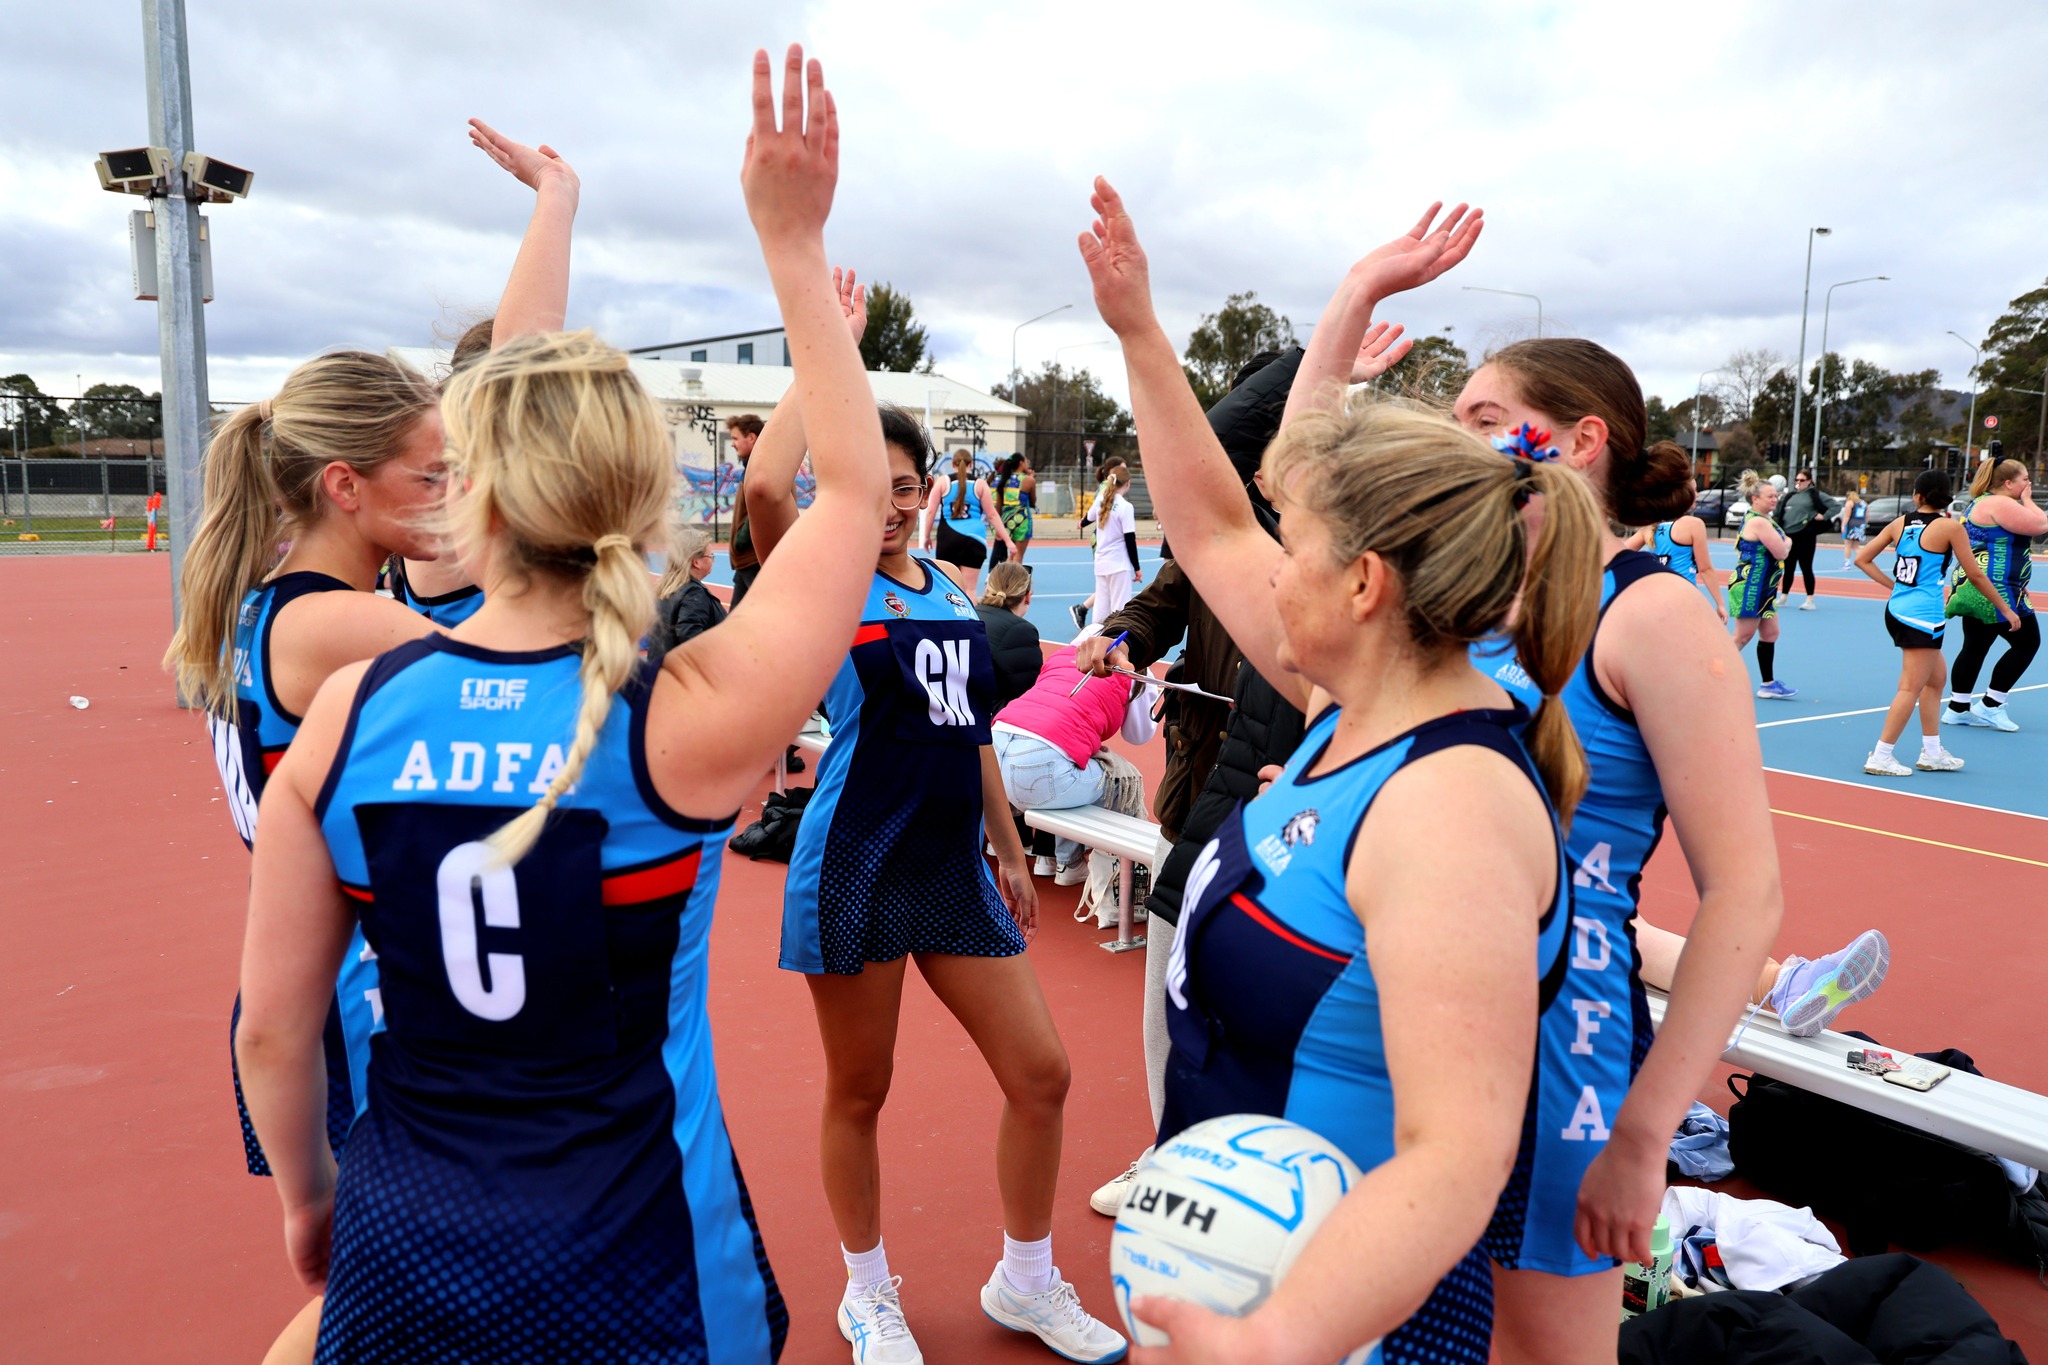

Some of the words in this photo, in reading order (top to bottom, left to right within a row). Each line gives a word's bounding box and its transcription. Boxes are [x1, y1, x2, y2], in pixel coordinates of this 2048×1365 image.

[1745, 585, 1758, 612] SOUTH
[459, 696, 526, 711] SPORT
[392, 739, 577, 796] ADFA
[436, 840, 527, 1022] C
[1561, 841, 1618, 1142] ADFA
